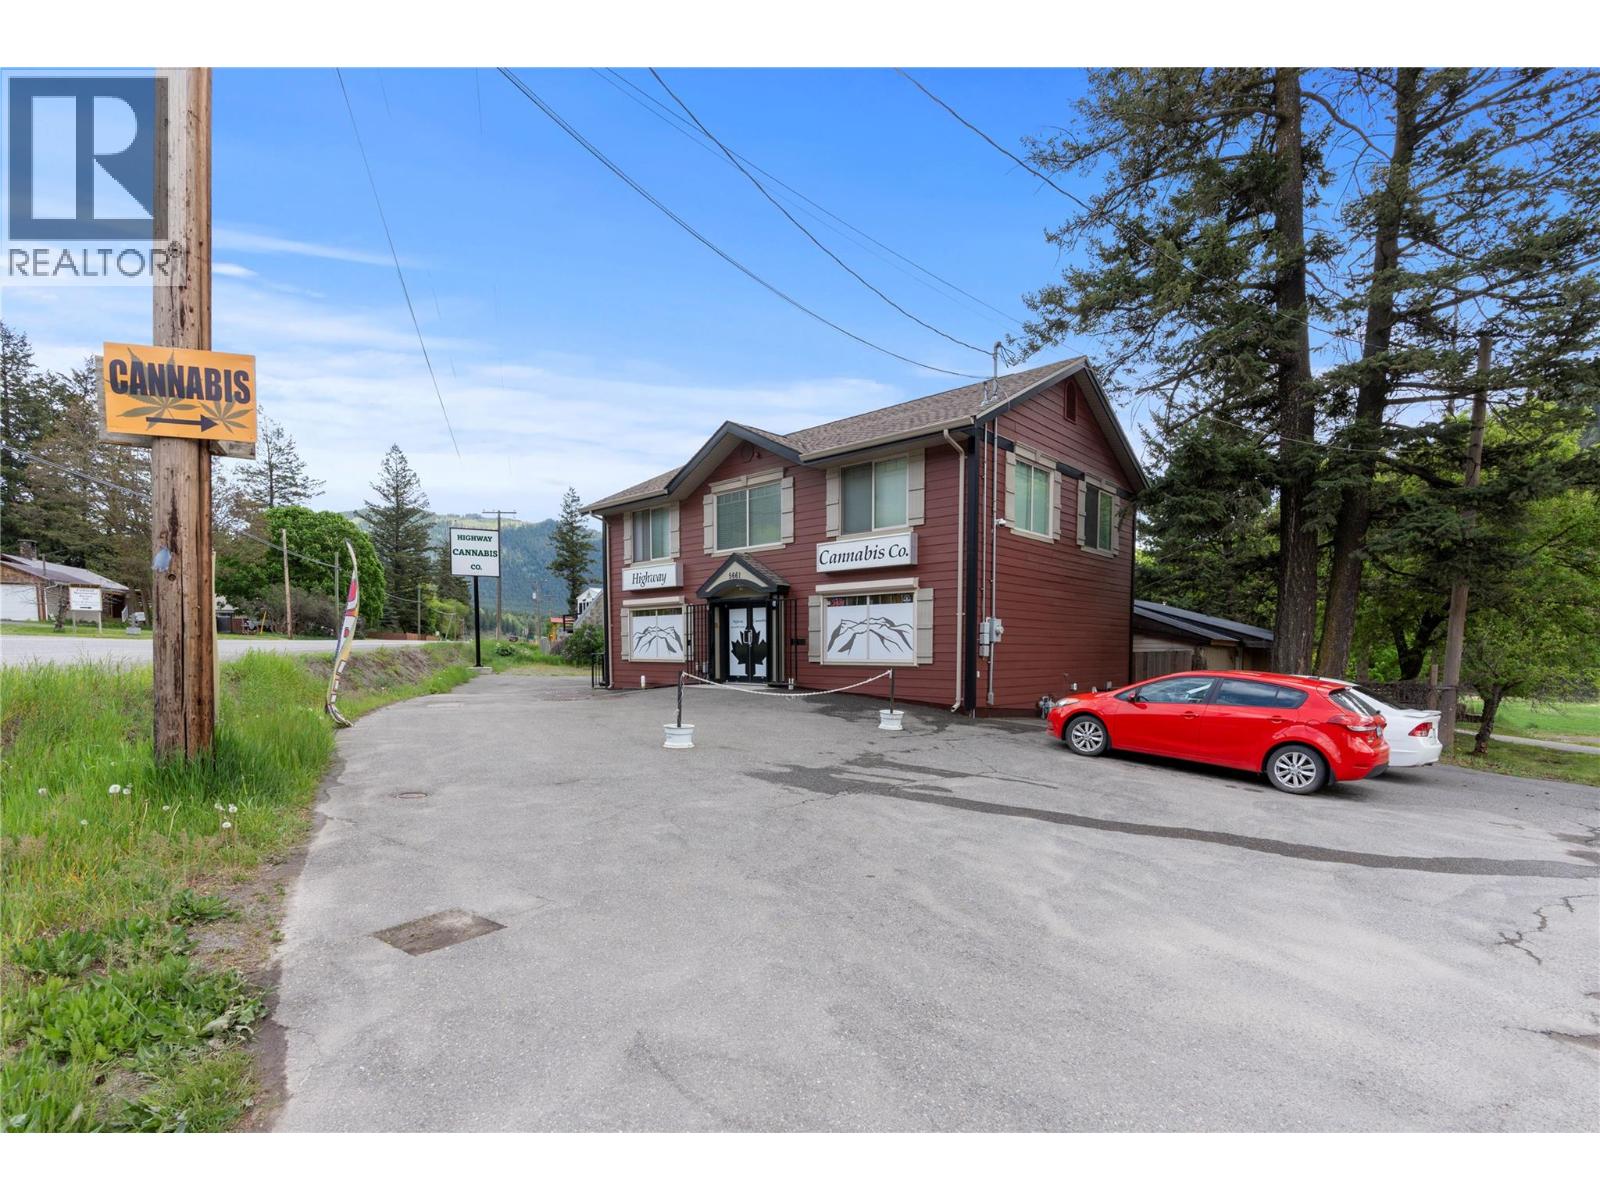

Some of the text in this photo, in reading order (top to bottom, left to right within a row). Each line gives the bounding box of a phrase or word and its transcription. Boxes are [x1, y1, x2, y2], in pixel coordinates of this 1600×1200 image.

[109, 358, 250, 404] CANNABIS
[457, 534, 493, 542] HIGHWAY
[452, 548, 498, 557] CANNABIS
[819, 544, 909, 565] Cannabis Co.
[632, 571, 667, 587] Highway
